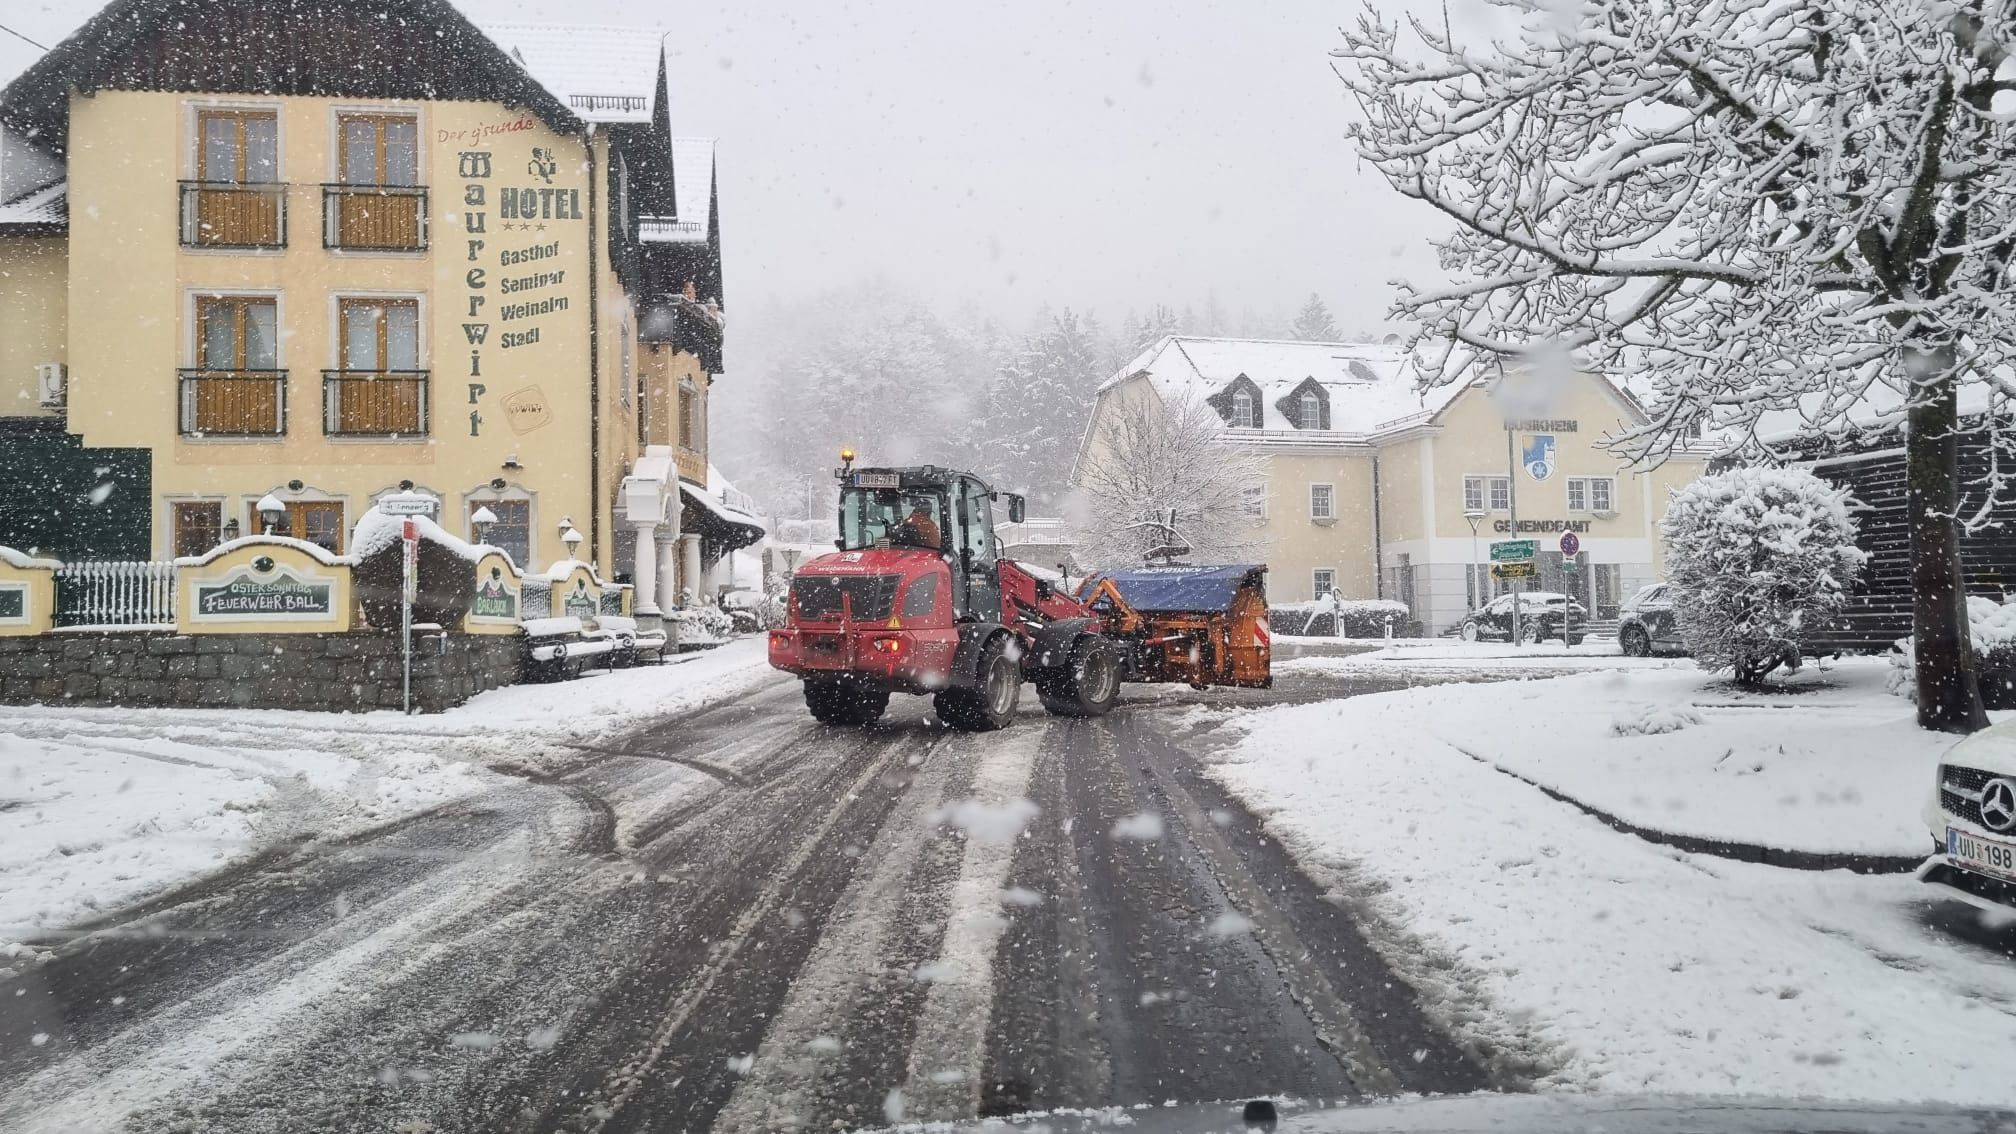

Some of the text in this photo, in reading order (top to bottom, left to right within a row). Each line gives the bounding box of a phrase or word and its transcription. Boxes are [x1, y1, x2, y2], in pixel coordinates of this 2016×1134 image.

[500, 187, 583, 219] HOTEL
[500, 240, 560, 266] Gasthof
[500, 270, 566, 295] Seminar
[500, 296, 569, 321] Weinalm
[501, 327, 540, 349] Stadl
[1493, 519, 1592, 533] GEMEINDEAMT
[202, 591, 282, 611] FEUERWEHR
[1959, 836, 2013, 869] UU 198
